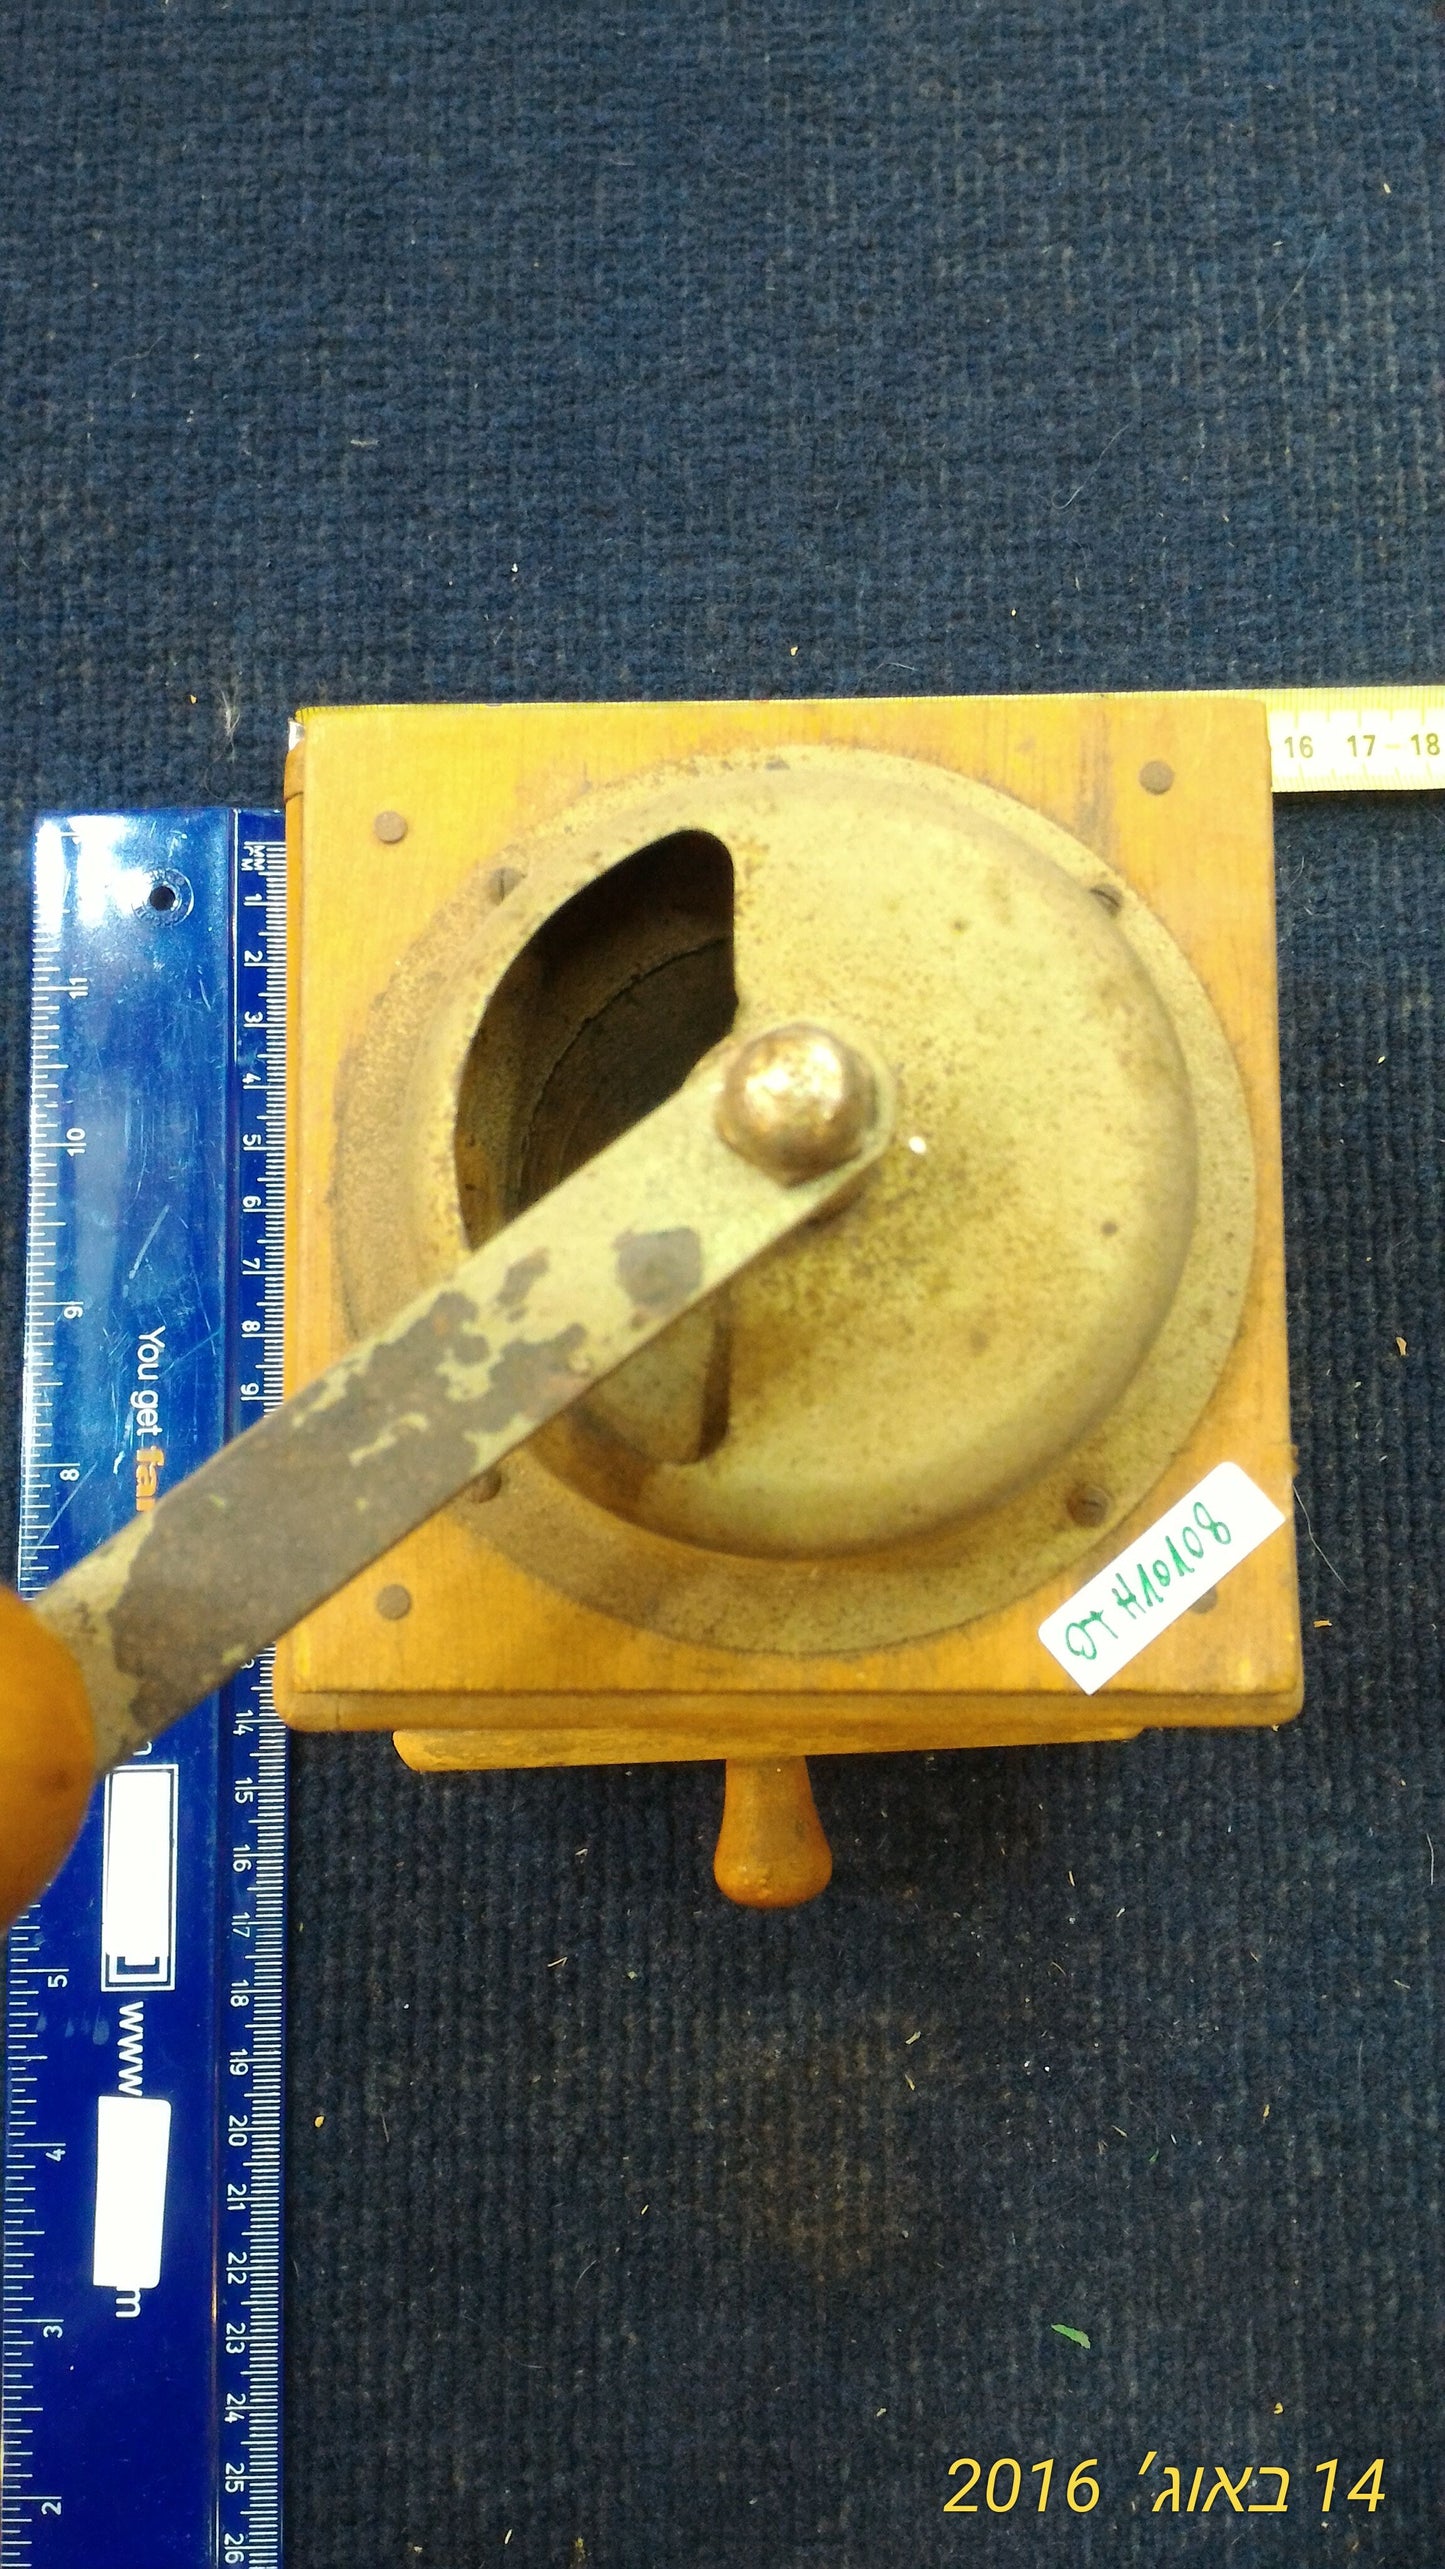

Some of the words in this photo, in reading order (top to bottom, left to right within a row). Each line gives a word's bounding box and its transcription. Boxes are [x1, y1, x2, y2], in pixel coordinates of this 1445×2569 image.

[1284, 735, 1314, 758] 16
[1347, 735, 1376, 757] 17
[1411, 733, 1441, 756] 18
[243, 894, 262, 903] 1
[244, 951, 262, 963] 2
[69, 978, 88, 998] 11
[244, 1012, 262, 1025] 3
[243, 1073, 261, 1085] 4
[67, 1127, 86, 1156] 10
[243, 1135, 262, 1146] 5
[242, 1196, 261, 1209] 6
[242, 1258, 260, 1270] 7
[64, 1306, 83, 1319] 9
[242, 1321, 260, 1333] 8
[137, 1326, 166, 1380] You
[241, 1383, 259, 1395] 9
[131, 1389, 163, 1436] get
[60, 1468, 80, 1482] 8
[233, 1710, 253, 1735] 14
[235, 1778, 254, 1803] 15
[233, 1845, 251, 1872] 16
[232, 1913, 250, 1938] 17
[47, 1974, 68, 1988] 5
[230, 1980, 248, 2007] 18
[118, 2001, 144, 2096] www
[229, 2049, 248, 2076] 19
[227, 2114, 248, 2148] 20
[46, 2149, 66, 2161] 4
[227, 2184, 246, 2210] 21
[228, 2252, 246, 2284] 22
[43, 2325, 63, 2338] 3
[226, 2322, 245, 2354] 23
[225, 2394, 246, 2423] 24
[225, 2463, 244, 2493] 25
[41, 2502, 61, 2515] 2
[224, 2533, 244, 2564] 26
